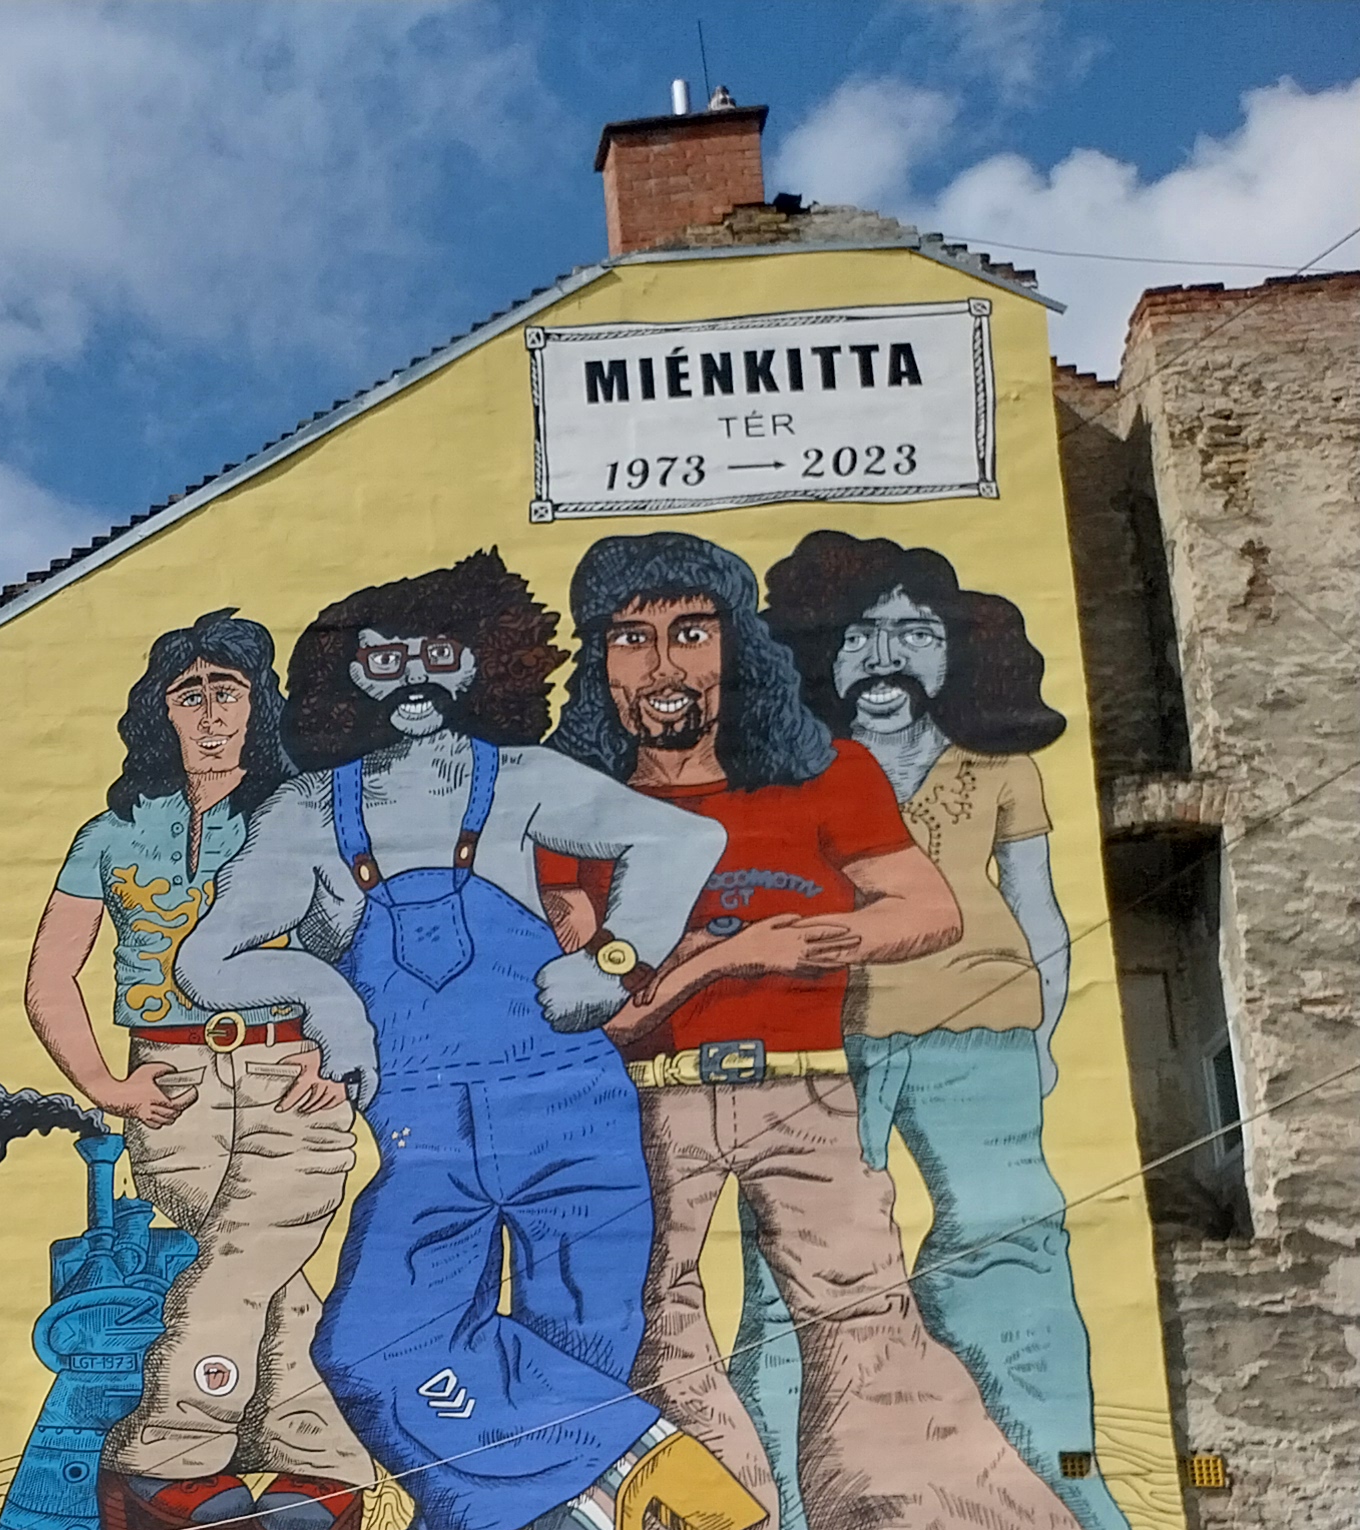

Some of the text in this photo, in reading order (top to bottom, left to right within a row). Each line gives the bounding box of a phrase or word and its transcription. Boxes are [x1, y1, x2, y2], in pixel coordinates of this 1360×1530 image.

[584, 343, 922, 404] MIÉNKITTA
[718, 410, 796, 439] TÉR
[605, 444, 918, 491] 1973 2023
[704, 868, 824, 898] OCOMOTIV
[721, 887, 754, 910] GT
[72, 1356, 134, 1370] LGT-1973
